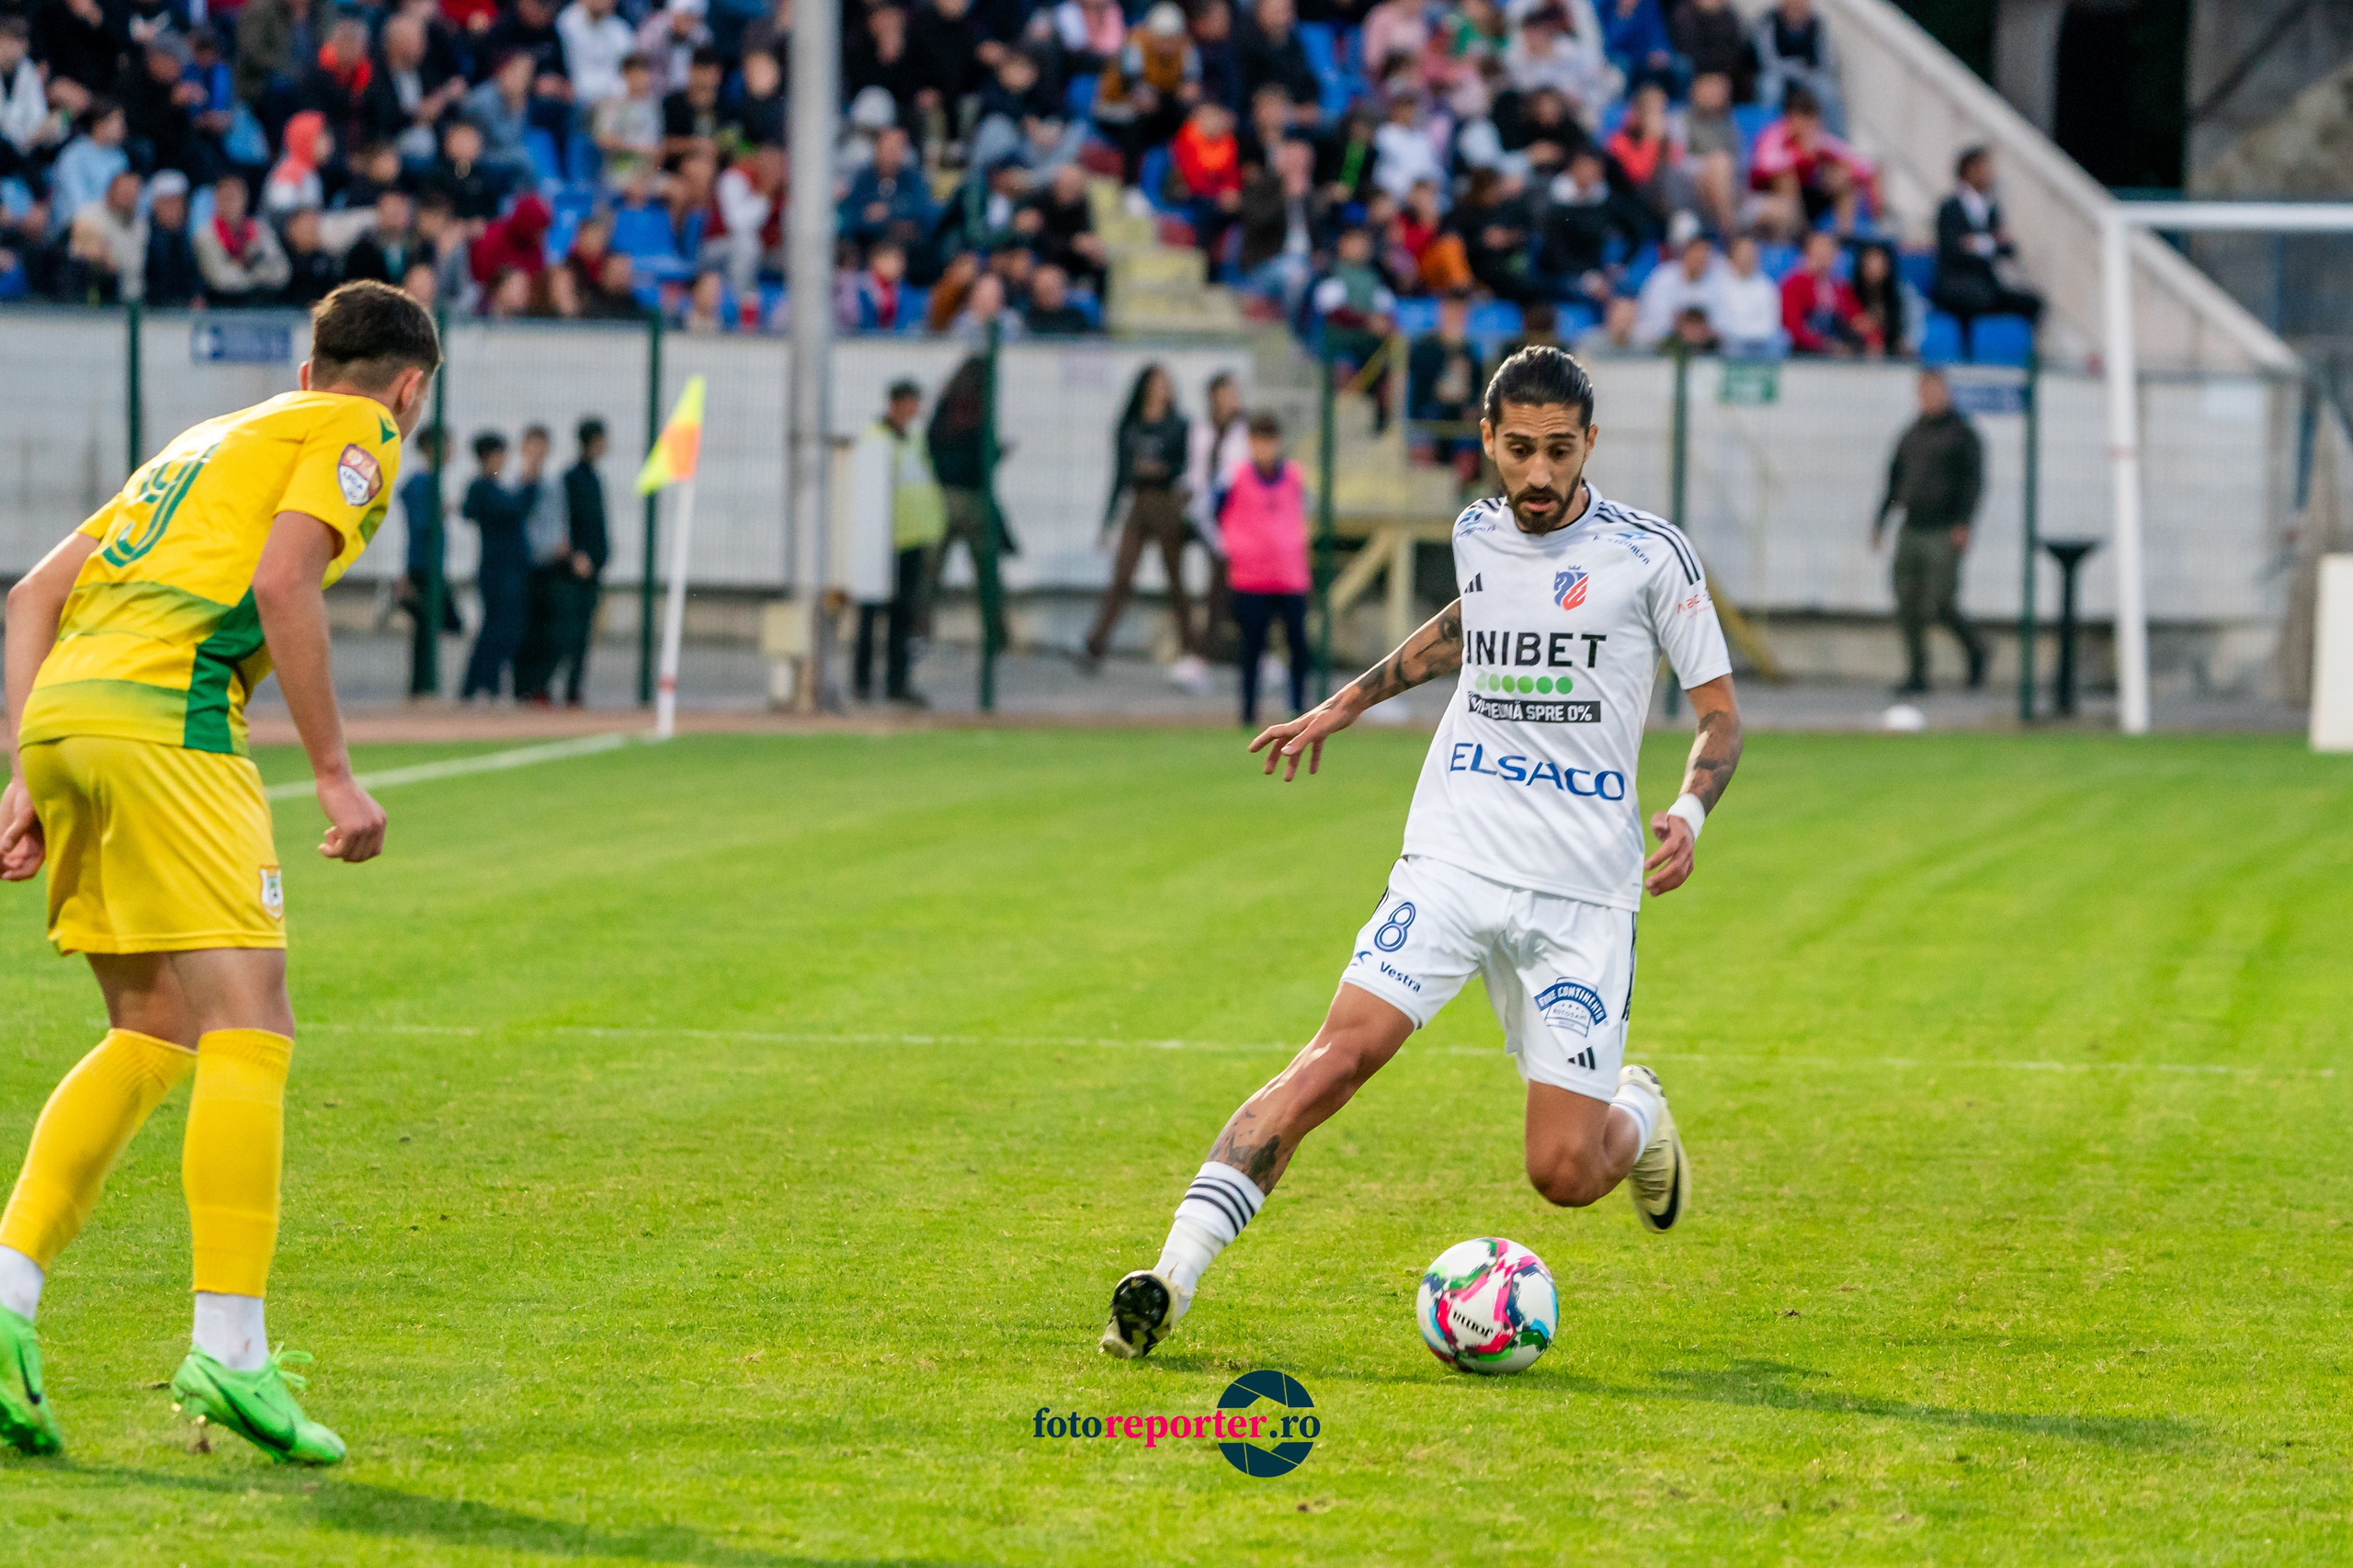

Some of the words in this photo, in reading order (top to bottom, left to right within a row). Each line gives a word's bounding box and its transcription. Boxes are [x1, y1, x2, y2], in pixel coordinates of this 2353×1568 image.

[1527, 705, 1564, 722] SPRE
[1567, 705, 1593, 722] 0%
[1450, 743, 1624, 801] ELSACO
[1374, 902, 1416, 952] 8
[1381, 961, 1421, 993] Vestra
